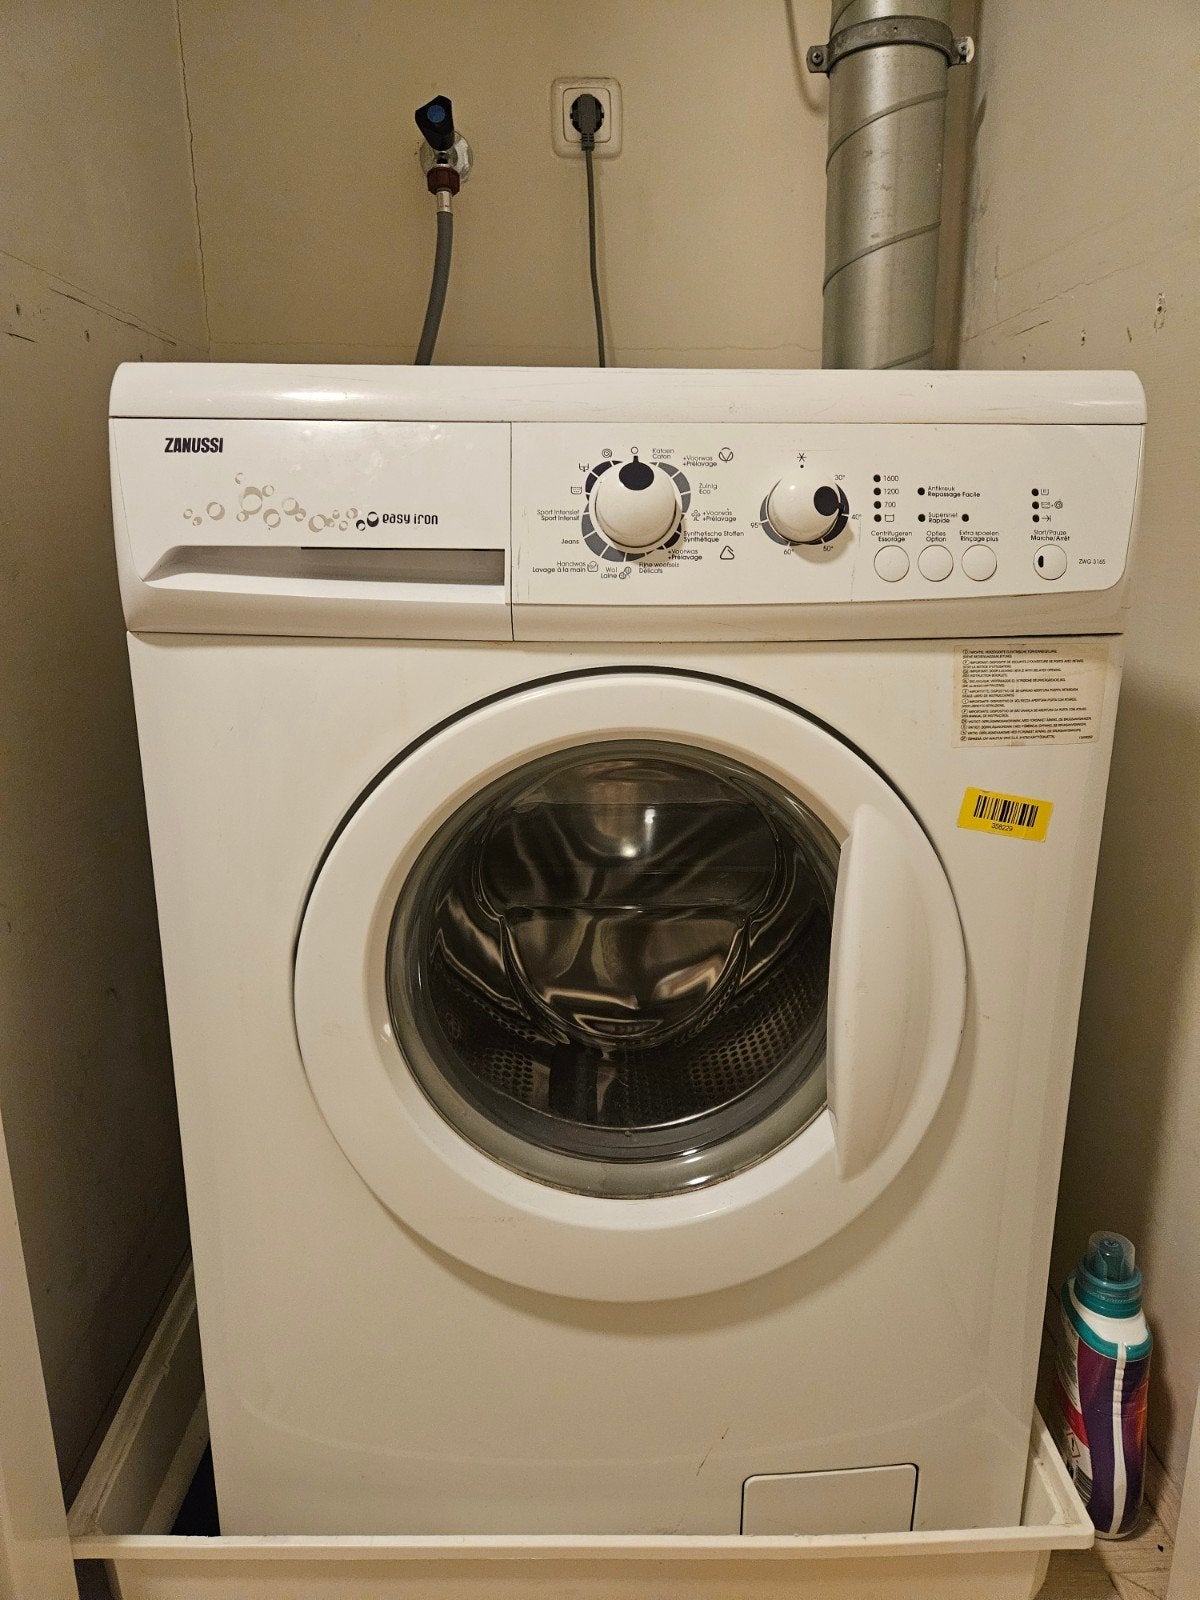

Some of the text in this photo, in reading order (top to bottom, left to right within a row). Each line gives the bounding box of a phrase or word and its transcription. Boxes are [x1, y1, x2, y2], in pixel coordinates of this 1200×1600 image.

[164, 437, 224, 453] ZANUSSI
[382, 513, 439, 525] easy iron
[532, 566, 556, 574] Lavage
